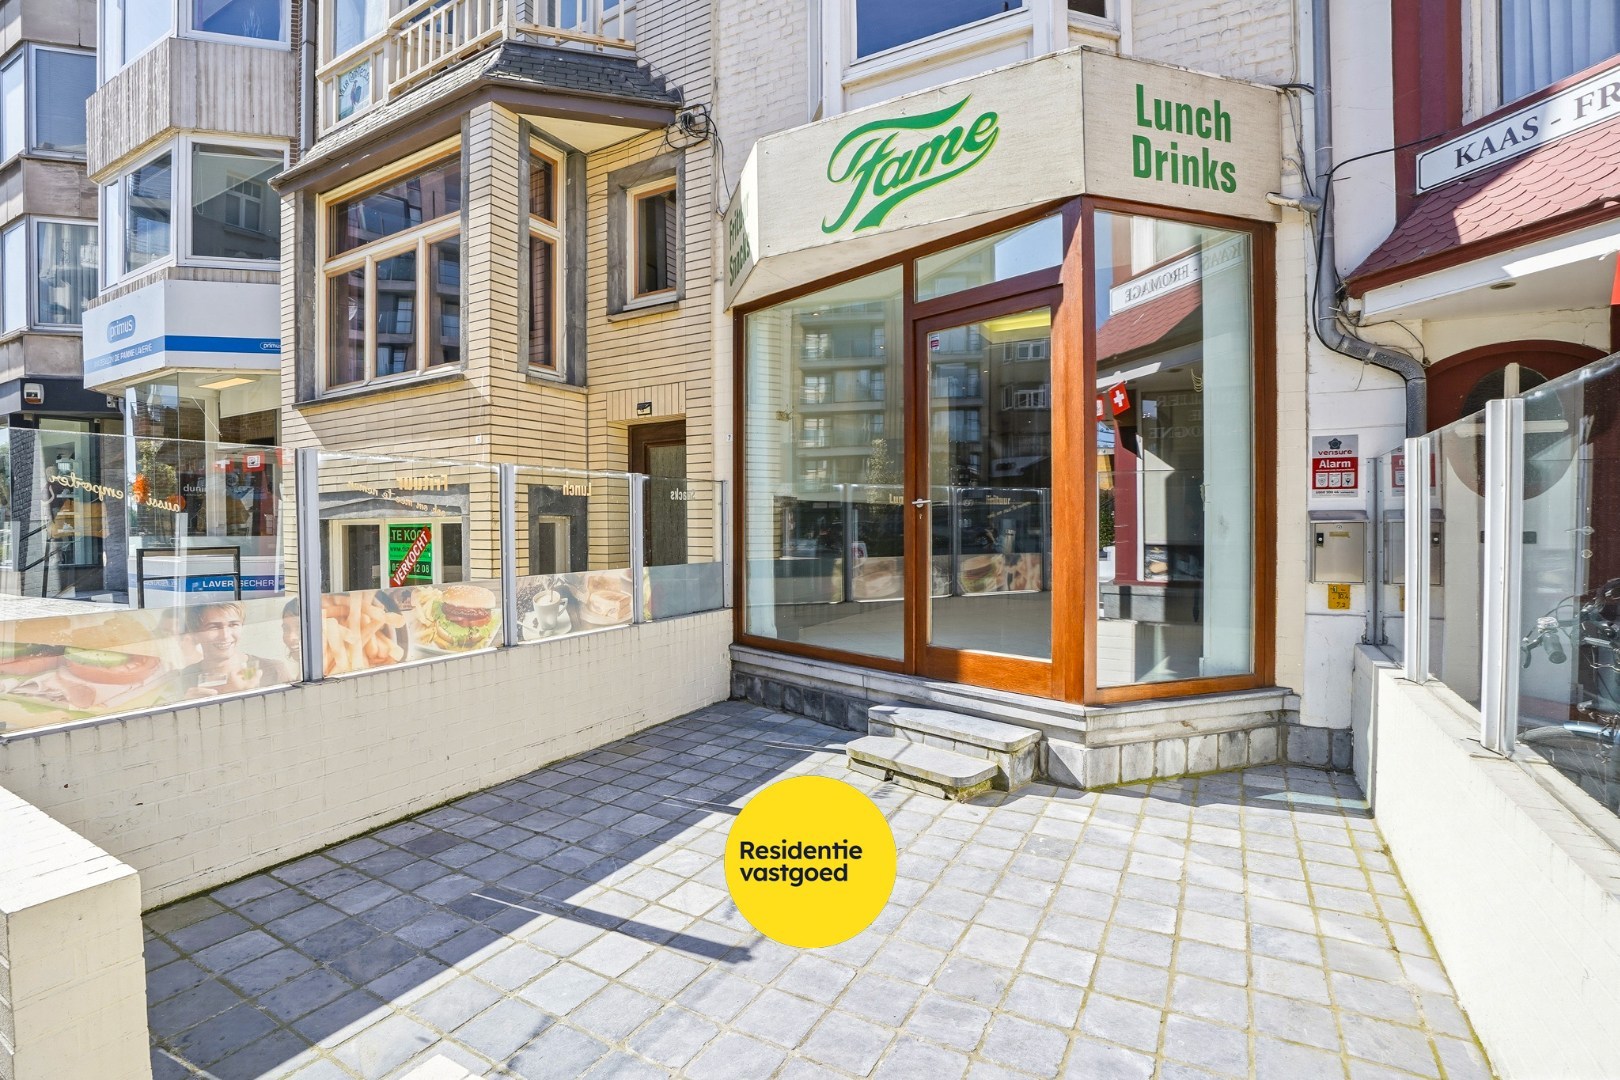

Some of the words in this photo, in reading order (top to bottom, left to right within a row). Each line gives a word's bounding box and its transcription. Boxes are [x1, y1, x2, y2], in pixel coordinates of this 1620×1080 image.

[1136, 83, 1231, 143] Lunch
[822, 92, 1000, 234] Fame
[1132, 134, 1237, 194] Drinks
[1454, 115, 1539, 169] KAAS
[729, 231, 751, 287] Snacks
[111, 319, 133, 338] primus
[1319, 459, 1351, 469] Alarm
[391, 529, 402, 541] TE
[393, 530, 428, 586] VERKOCHT
